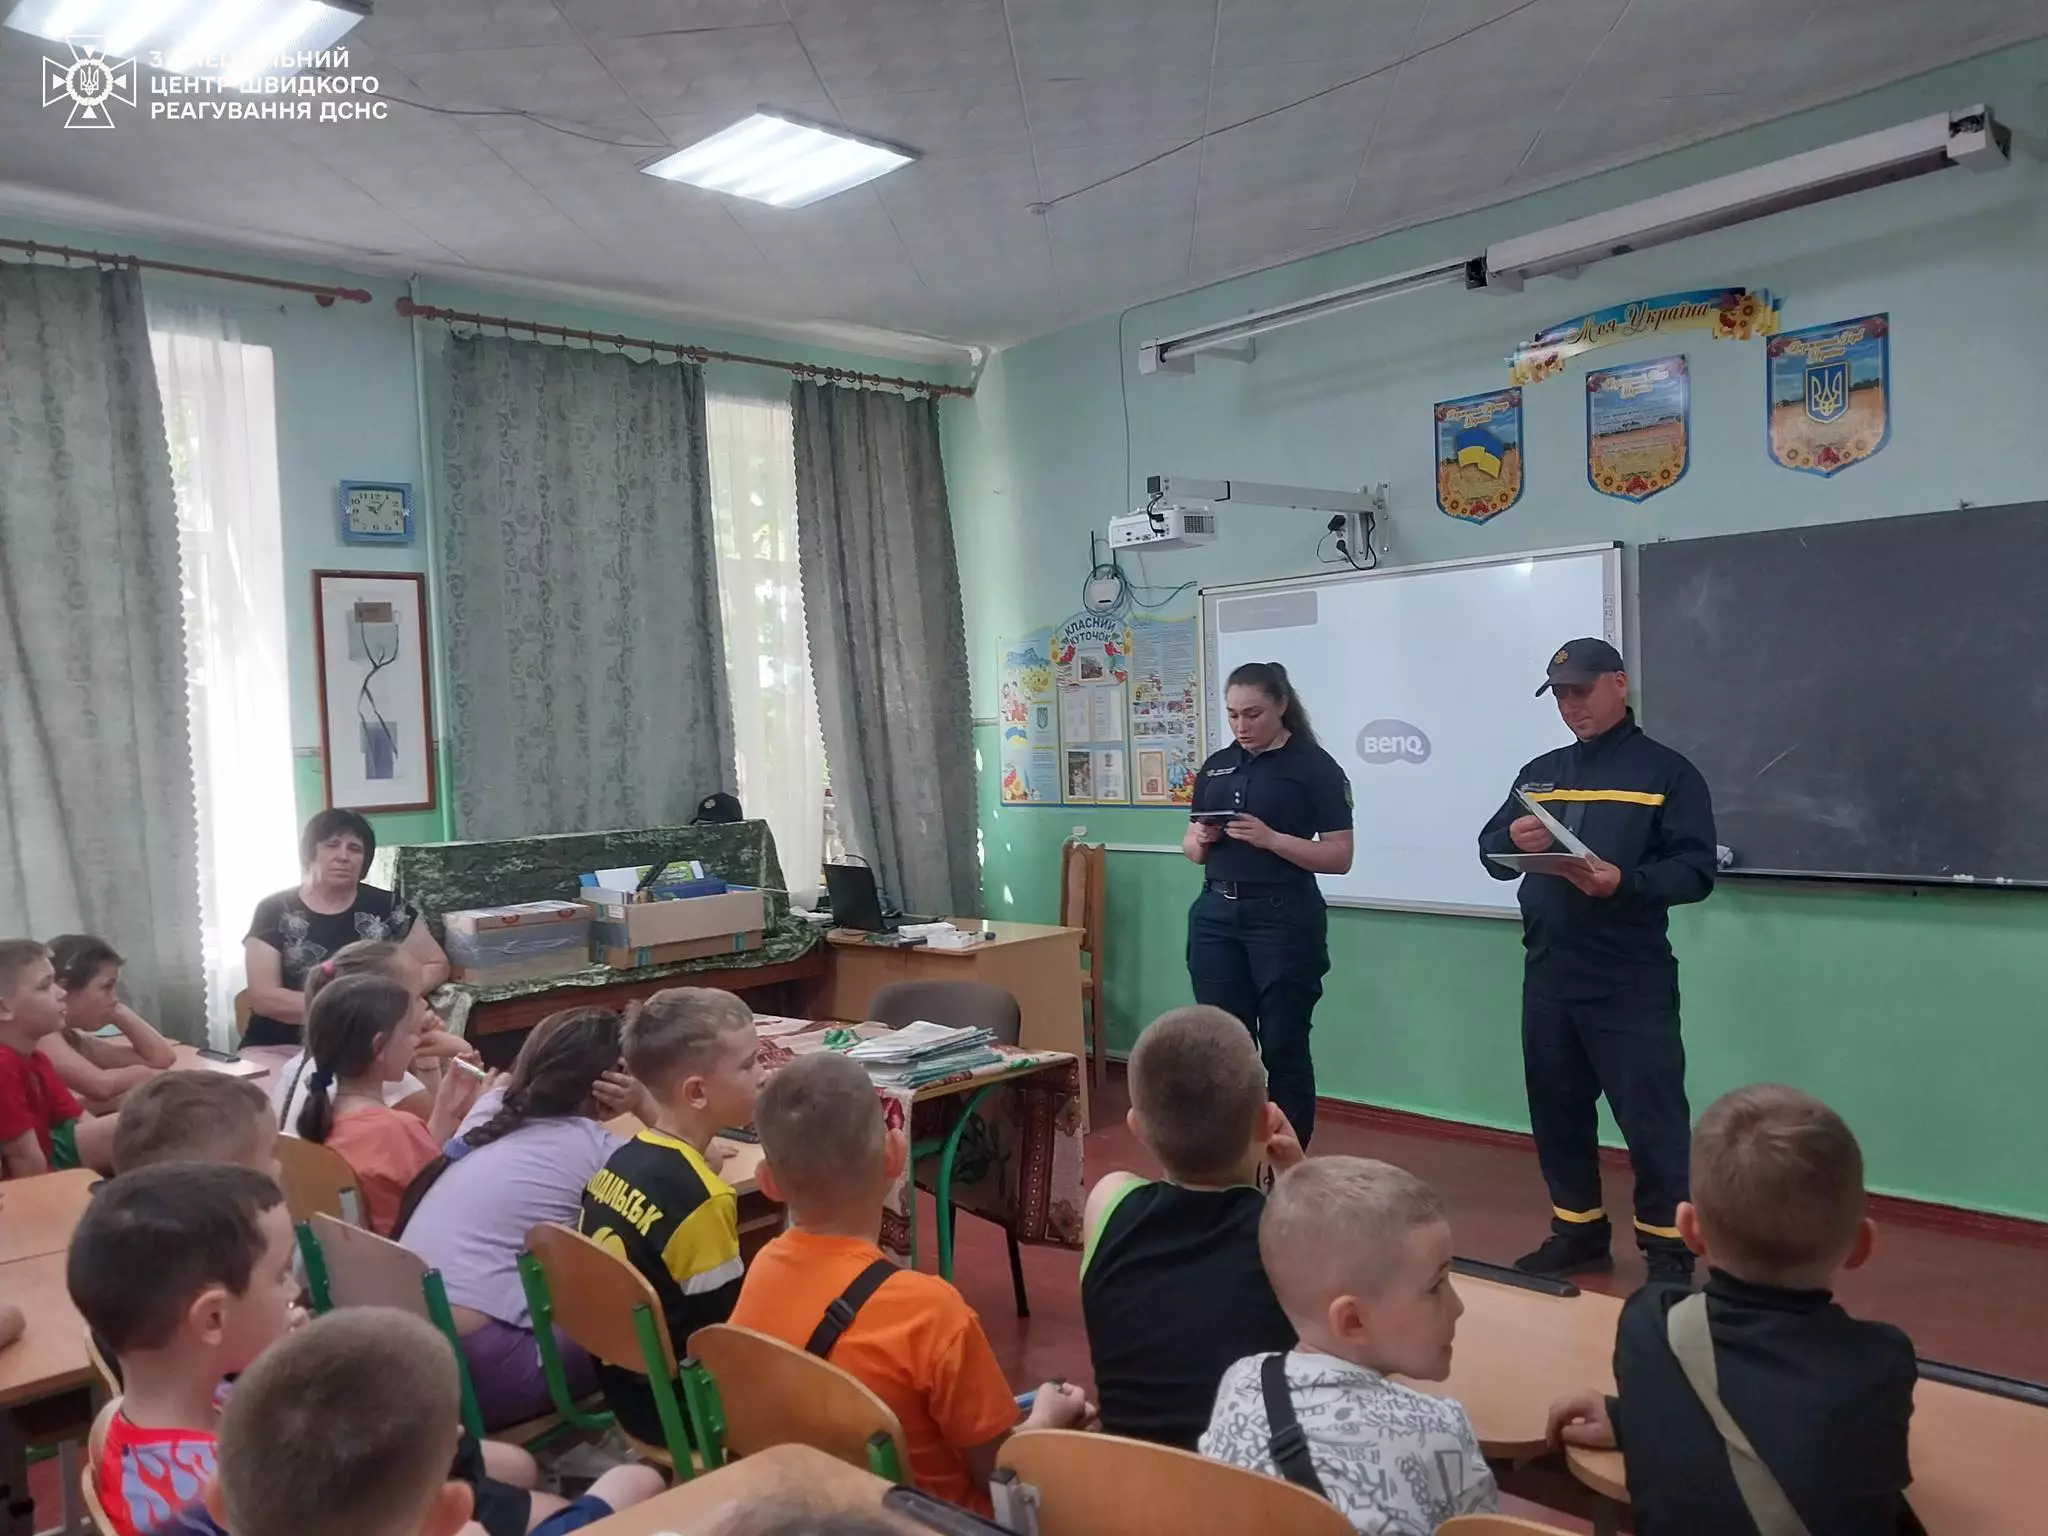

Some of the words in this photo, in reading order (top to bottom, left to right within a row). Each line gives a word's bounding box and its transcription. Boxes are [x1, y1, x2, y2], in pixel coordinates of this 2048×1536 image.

[1065, 617, 1116, 637] КЛАСНИЙ
[1070, 631, 1111, 645] КУТОЧОК
[1364, 735, 1424, 756] BenQ
[586, 1167, 665, 1237] ОДІЛЬСЬК
